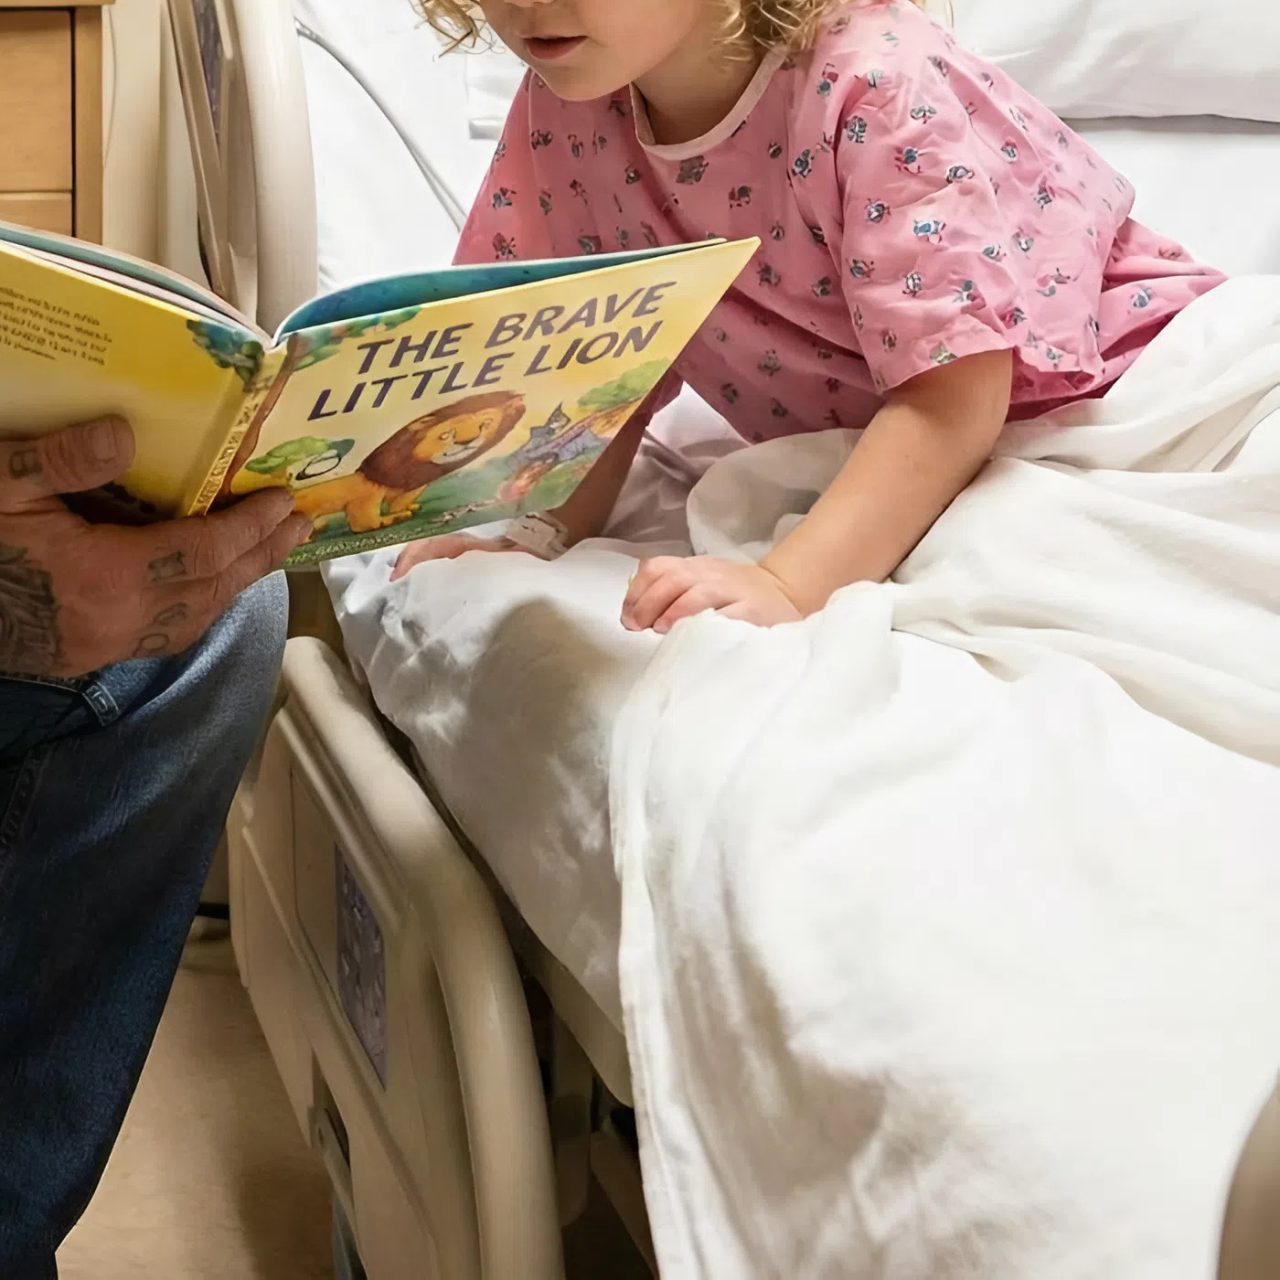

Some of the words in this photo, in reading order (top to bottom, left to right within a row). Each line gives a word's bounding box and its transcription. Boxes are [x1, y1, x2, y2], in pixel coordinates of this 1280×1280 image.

[308, 351, 512, 421] LITTLE
[523, 321, 663, 377] LION
[357, 322, 473, 375] THE
[485, 280, 677, 348] BRAVE
